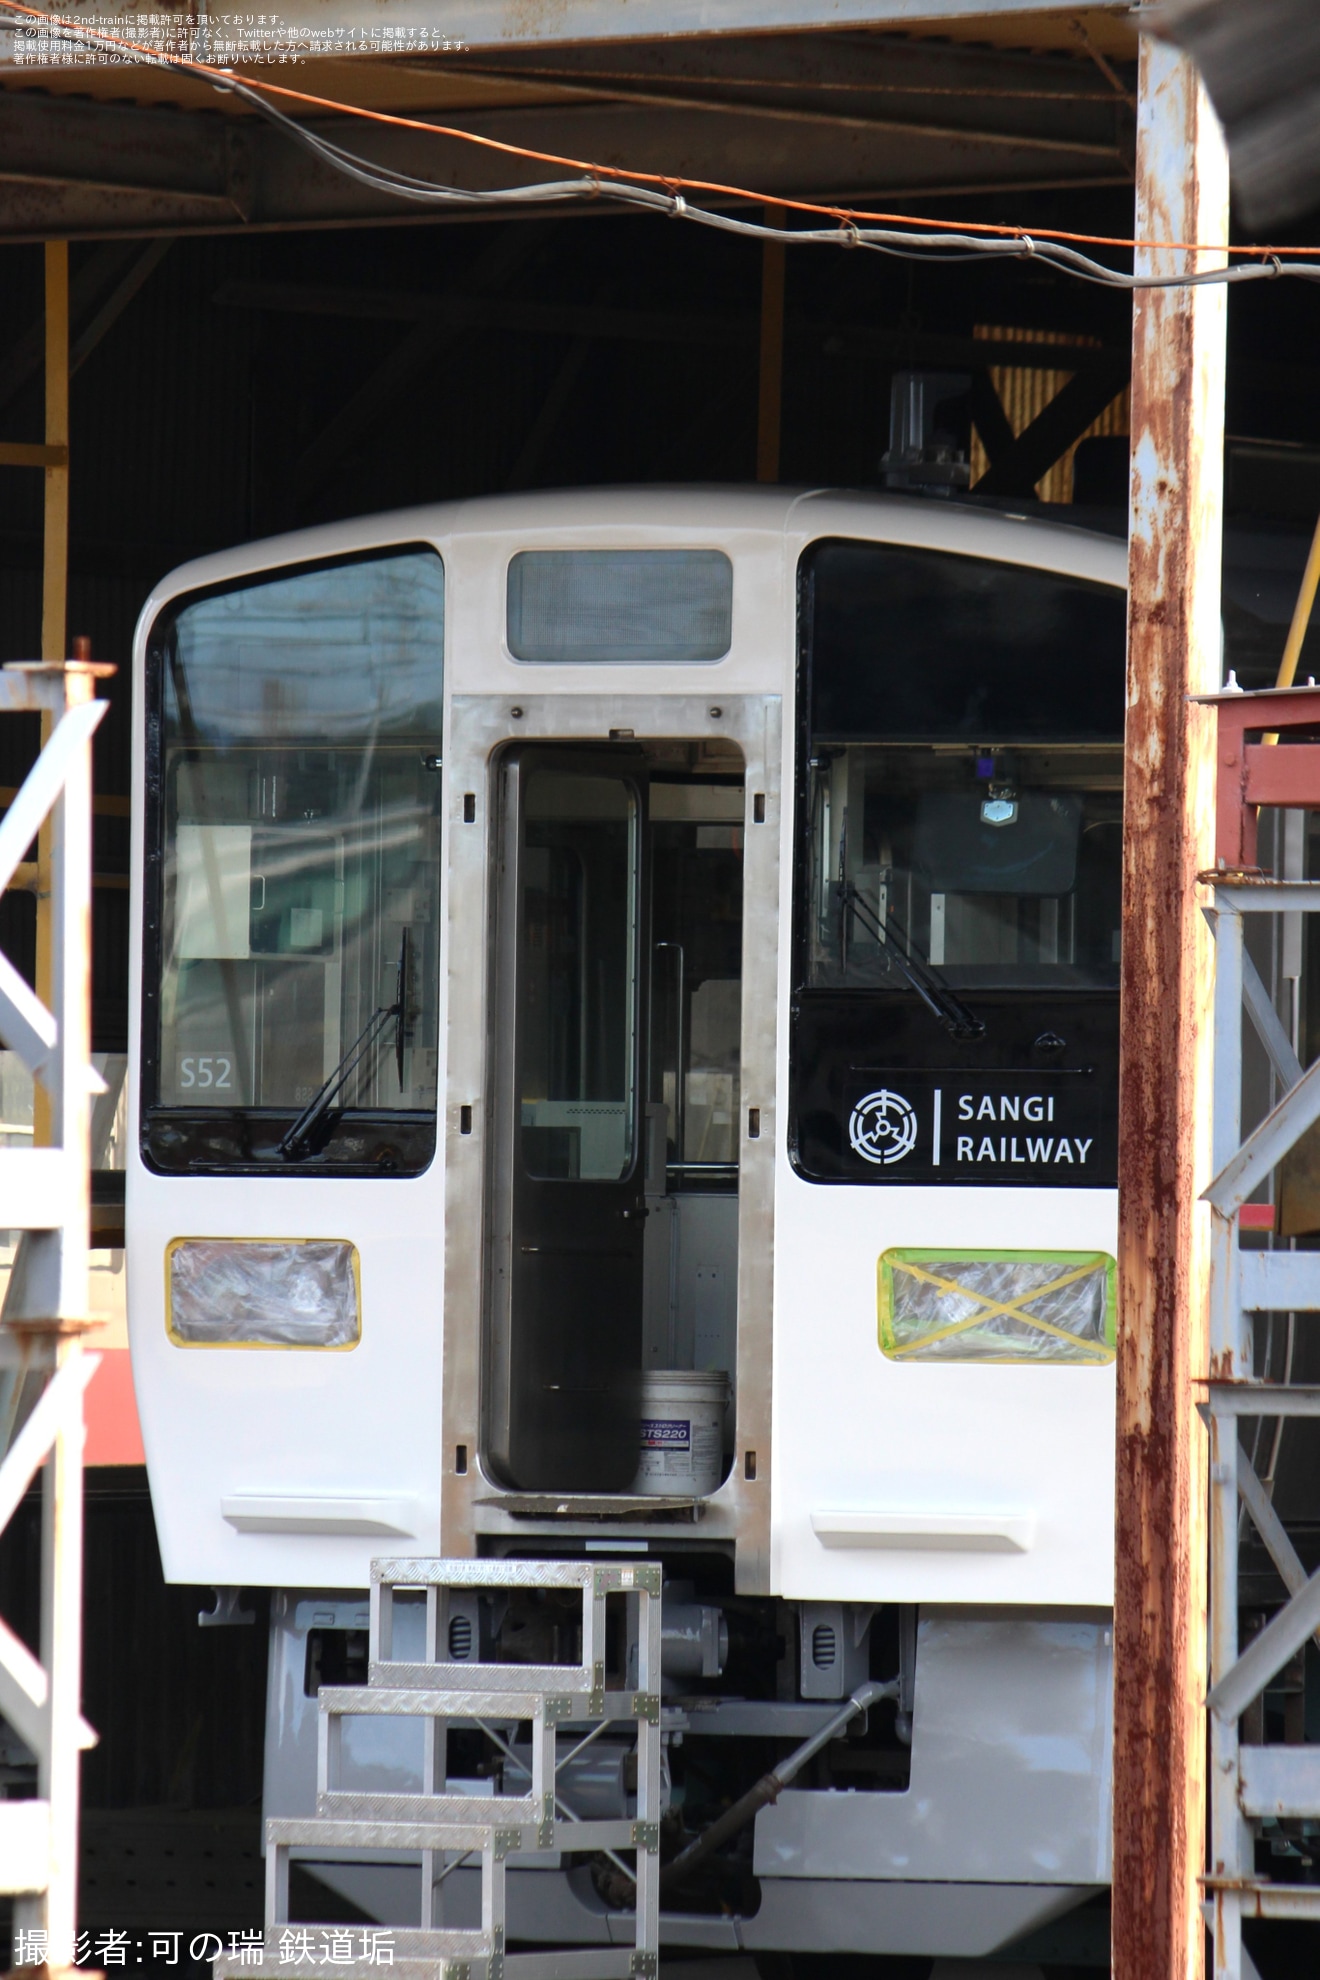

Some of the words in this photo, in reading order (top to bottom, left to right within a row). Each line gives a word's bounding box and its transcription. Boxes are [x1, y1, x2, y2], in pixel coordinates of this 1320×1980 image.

[181, 1058, 231, 1088] S52
[958, 1095, 1054, 1122] SANGI
[957, 1136, 1093, 1163] RAILWAY
